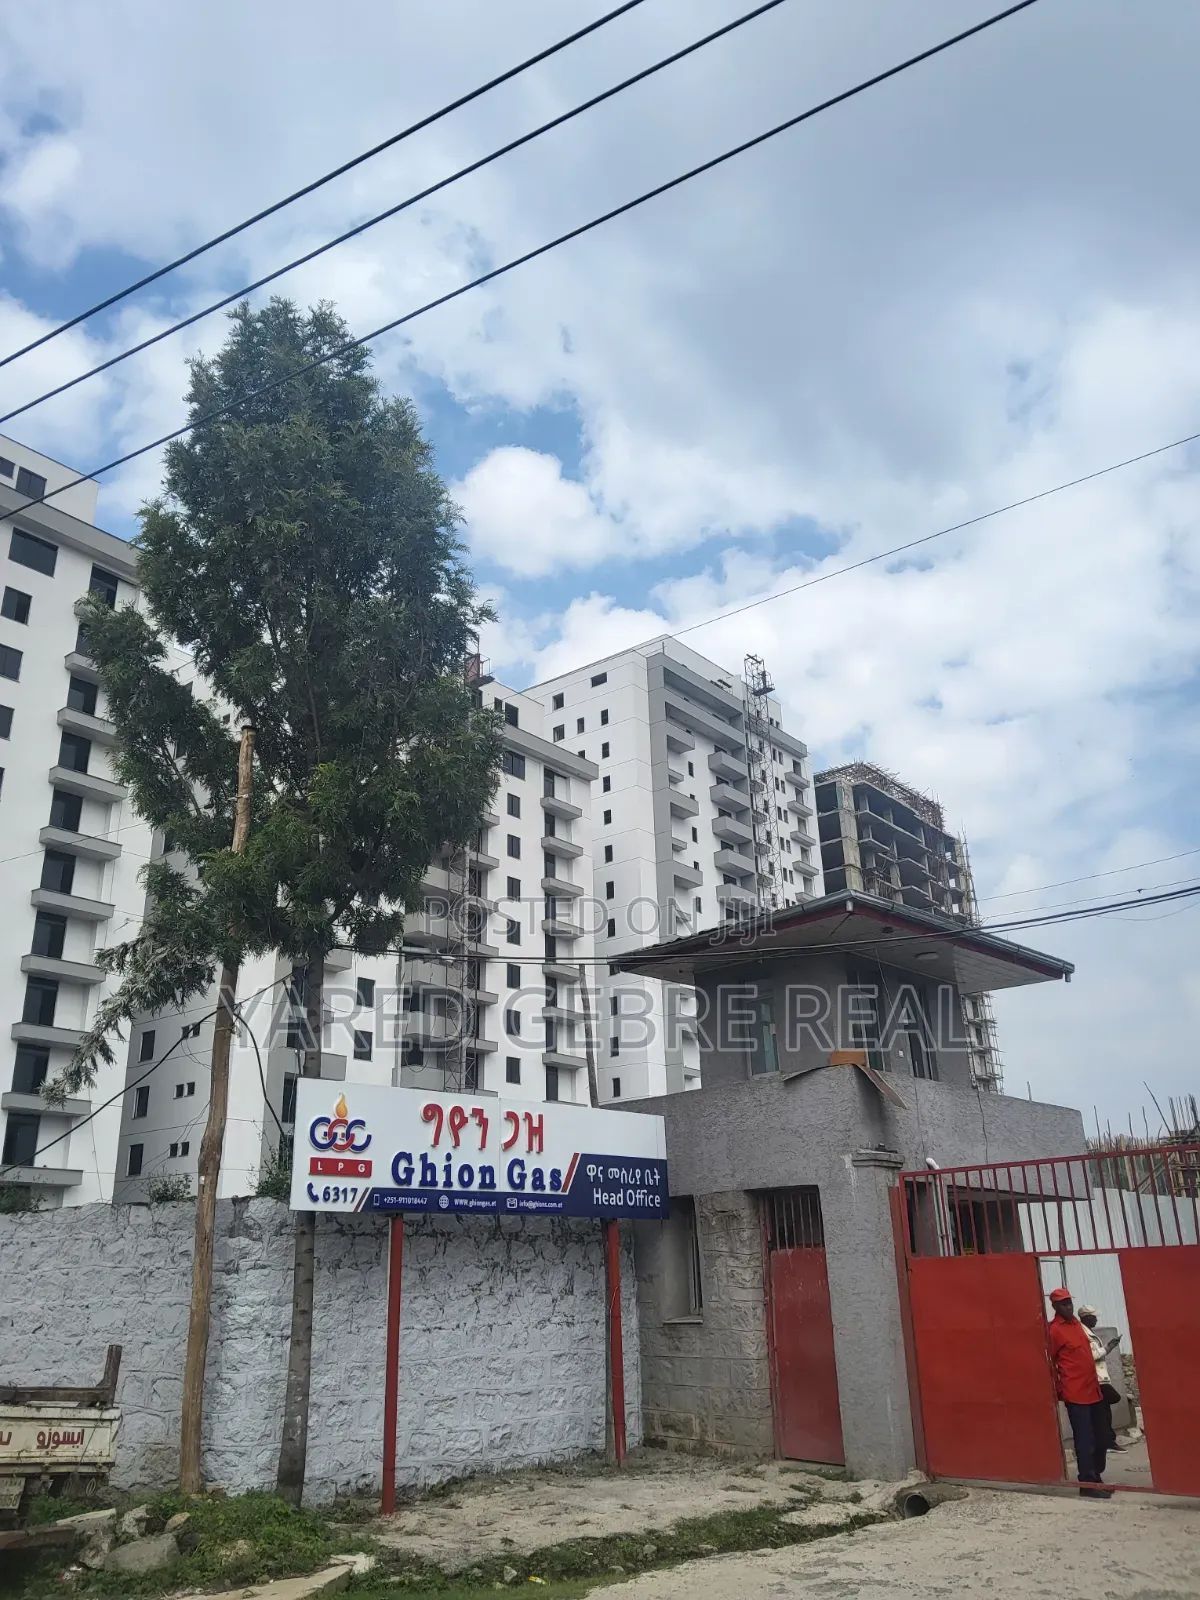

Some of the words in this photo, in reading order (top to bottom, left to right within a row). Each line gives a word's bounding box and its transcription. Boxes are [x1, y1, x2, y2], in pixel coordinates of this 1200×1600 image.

[422, 1103, 488, 1150] ግዮን
[502, 1110, 544, 1153] ጋዝ
[391, 1151, 496, 1189] Ghion
[507, 1158, 562, 1192] Gas
[586, 1164, 604, 1184] ዋና
[645, 1167, 661, 1187] ቤት
[322, 1186, 358, 1205] 6317
[593, 1187, 624, 1206] Head
[626, 1189, 661, 1208] Office
